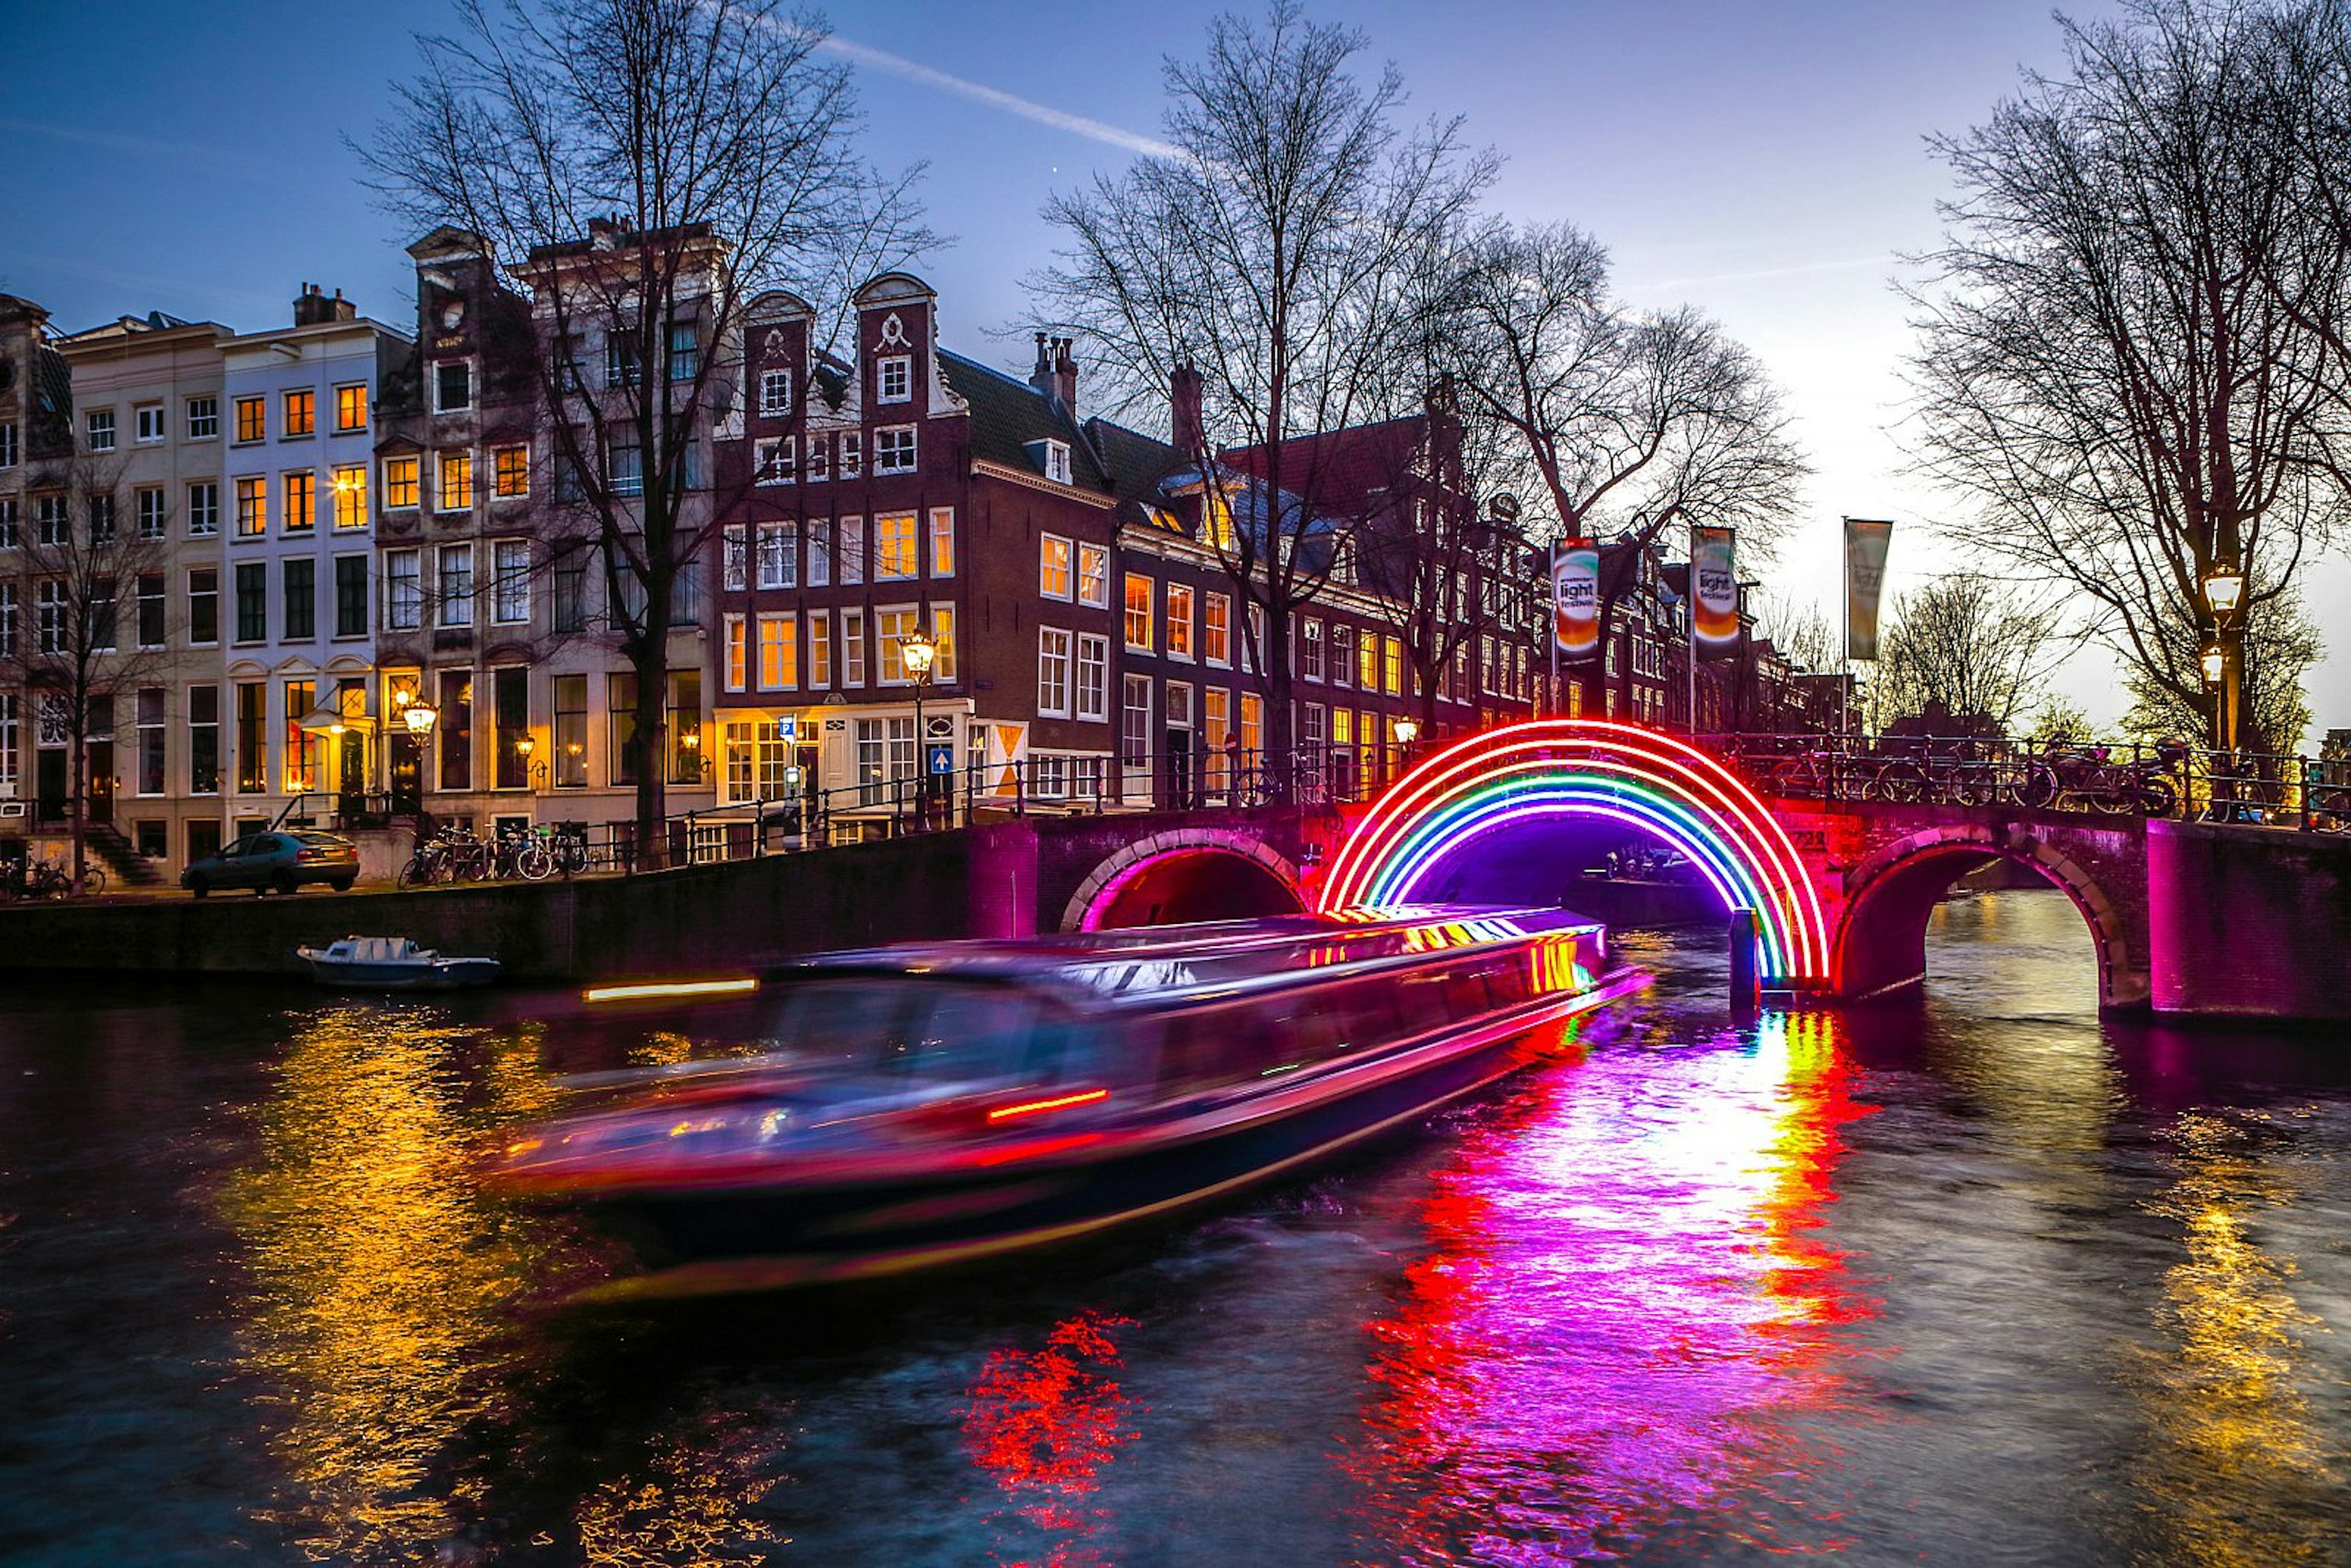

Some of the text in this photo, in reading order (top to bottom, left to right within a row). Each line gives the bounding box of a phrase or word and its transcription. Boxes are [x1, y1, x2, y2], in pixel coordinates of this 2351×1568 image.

[1700, 574, 1730, 591] light
[1561, 583, 1592, 599] light
[782, 724, 790, 733] P
